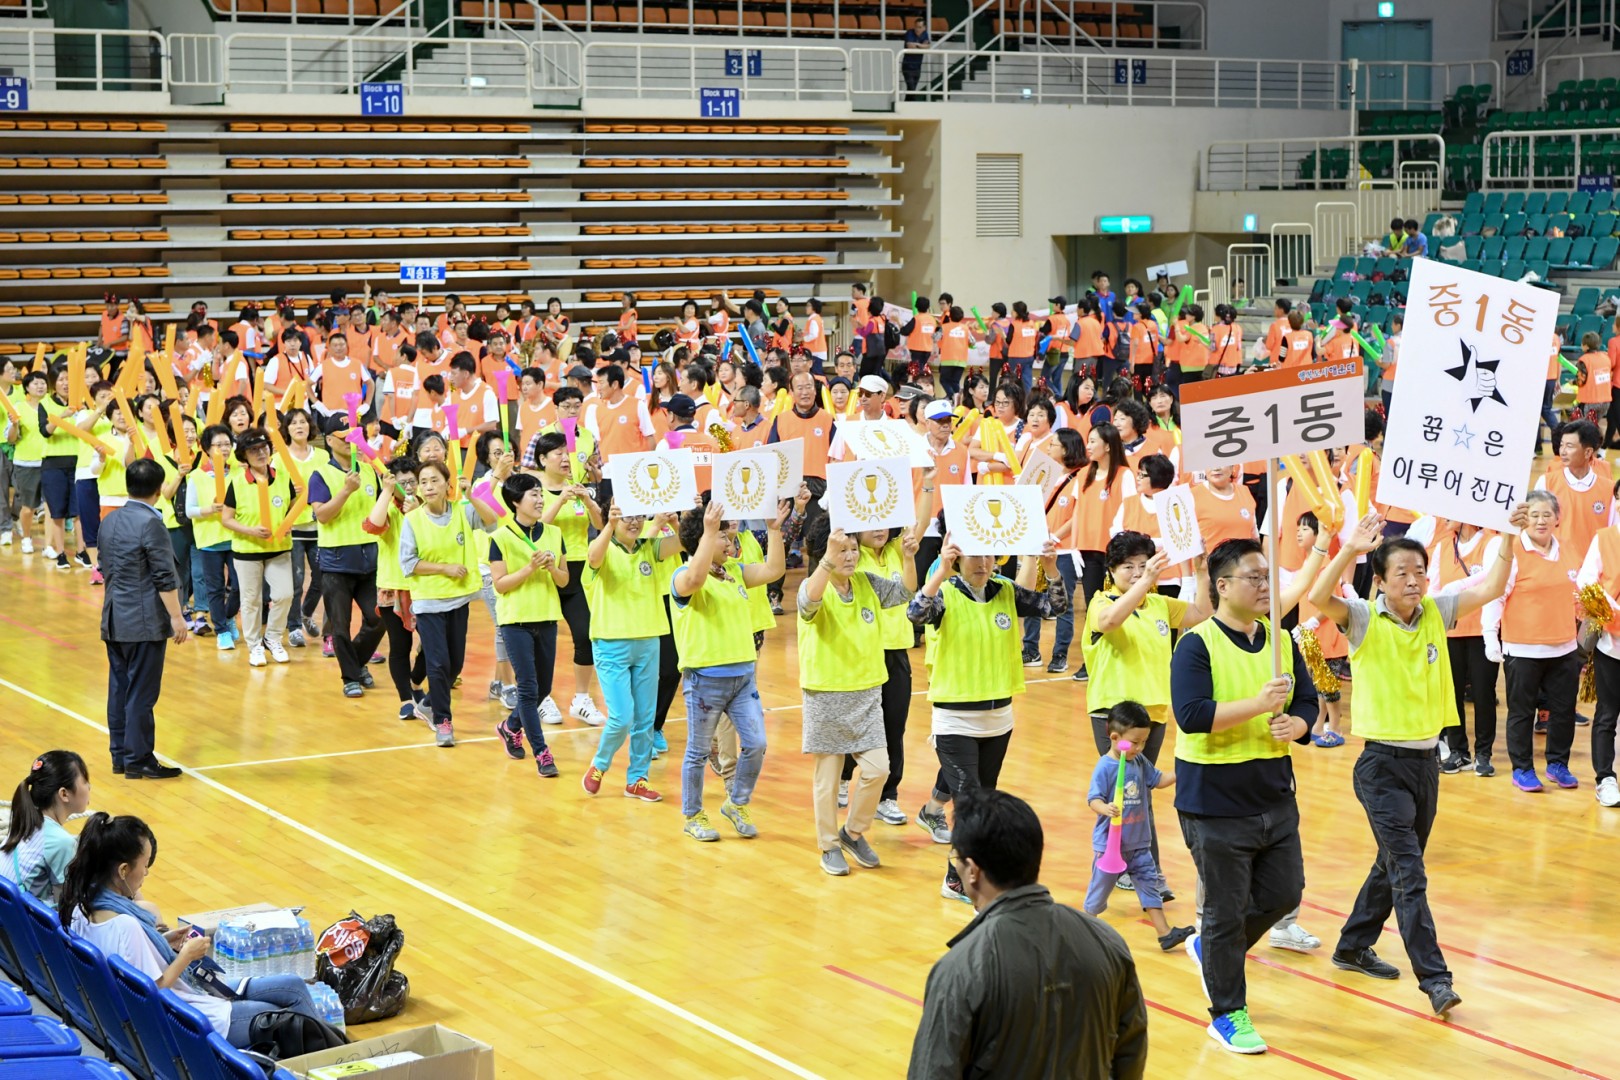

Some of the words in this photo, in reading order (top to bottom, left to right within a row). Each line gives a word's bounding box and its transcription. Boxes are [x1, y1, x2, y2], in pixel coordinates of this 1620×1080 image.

[366, 95, 400, 113] 1-10
[706, 100, 733, 117] 1-11
[1204, 391, 1342, 458] 중1동
[1422, 415, 1443, 443] 꿈
[1484, 430, 1504, 457] 은
